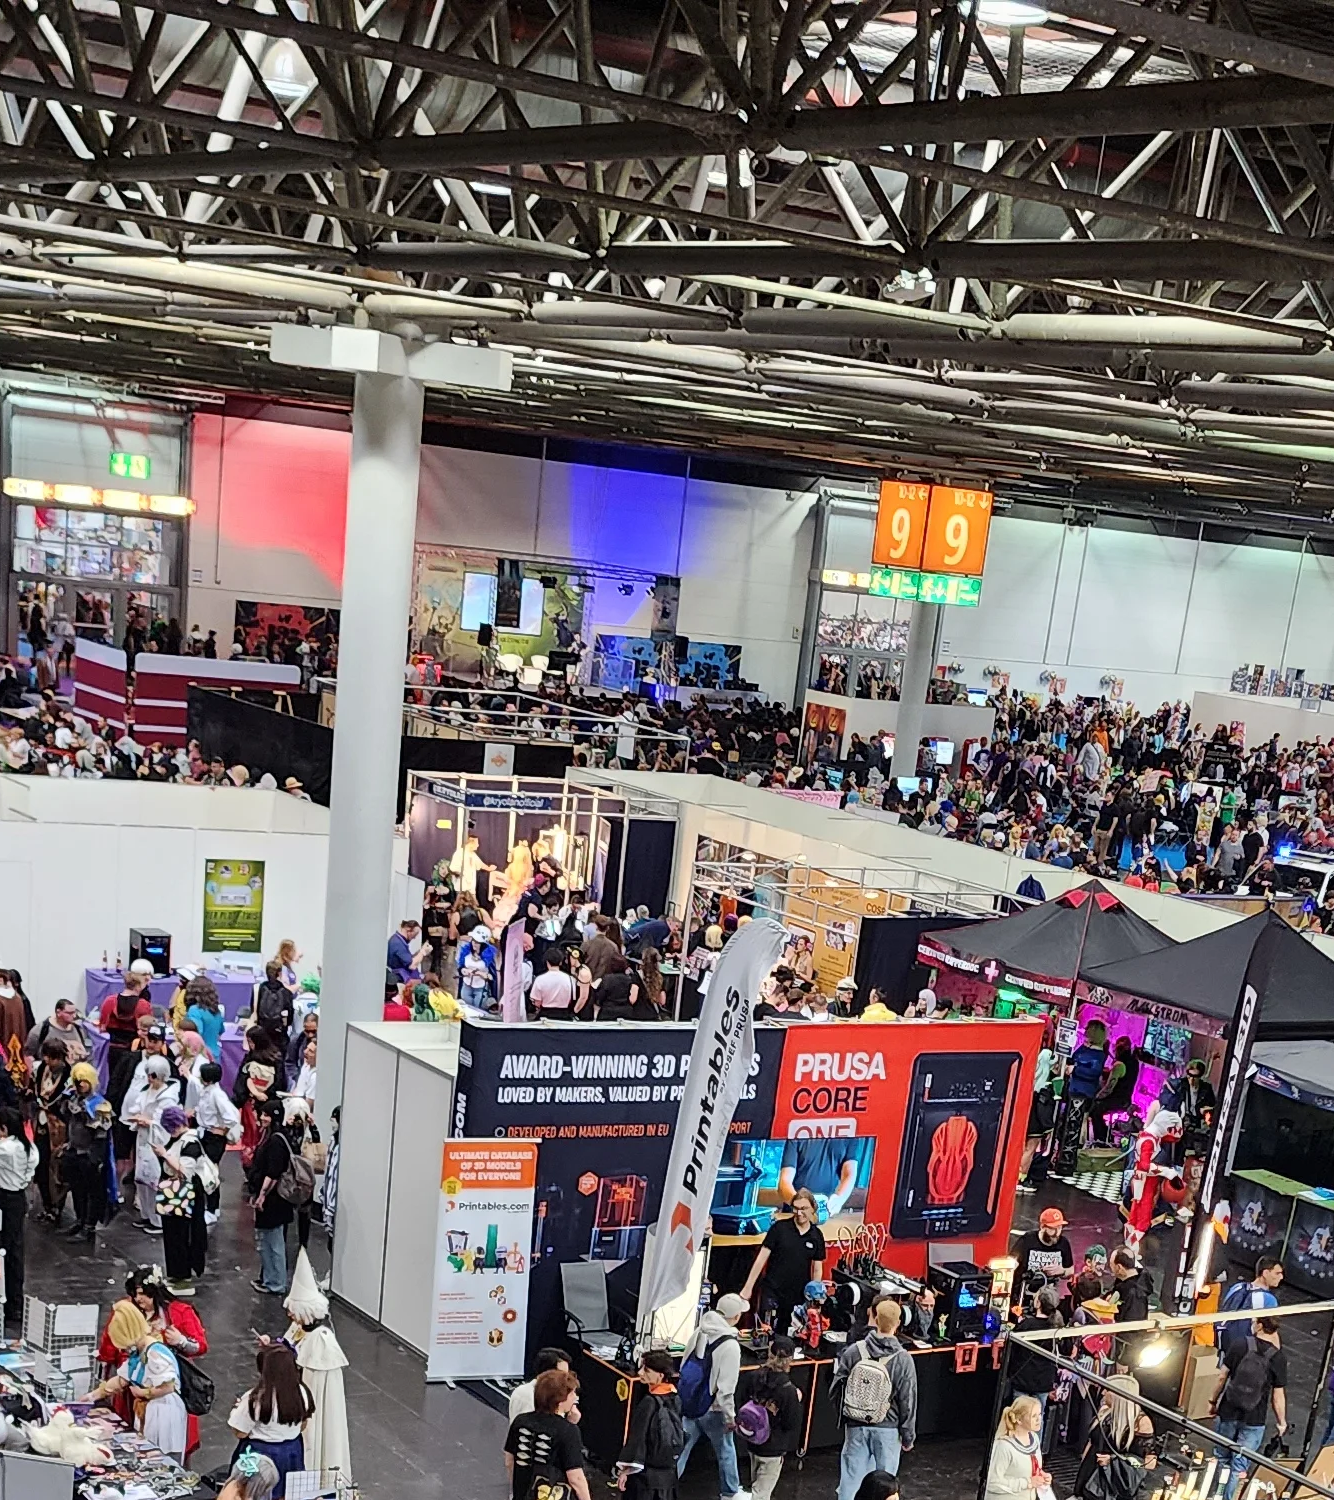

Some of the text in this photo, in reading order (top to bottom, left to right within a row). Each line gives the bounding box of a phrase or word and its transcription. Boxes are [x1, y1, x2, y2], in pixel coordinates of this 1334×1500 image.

[889, 507, 911, 559] 9
[943, 514, 969, 565] 9
[723, 1041, 737, 1078] JOSEF
[734, 998, 750, 1040] PRUSA
[500, 1055, 649, 1079] AWARD-WINNING
[651, 1055, 676, 1078] 3D
[794, 1051, 886, 1082] PRUSA
[497, 1087, 535, 1103] LOVED
[536, 1087, 552, 1102] BY
[555, 1087, 606, 1104] MAKERS,
[608, 1086, 651, 1102] VALUED
[652, 1086, 668, 1102] BY
[682, 985, 740, 1198] Printables
[792, 1086, 869, 1115] CORE
[455, 1093, 467, 1139] COM
[507, 1121, 752, 1138] DEVELOPED AND MANUFACTURED IN EU PORT
[794, 1125, 851, 1139] ONE
[449, 1151, 533, 1160] ULTIMATE DATABASE
[461, 1161, 522, 1171] OF 3D MODELS
[459, 1172, 522, 1181] FOR EVERYONE
[459, 1202, 530, 1213] Printables.com
